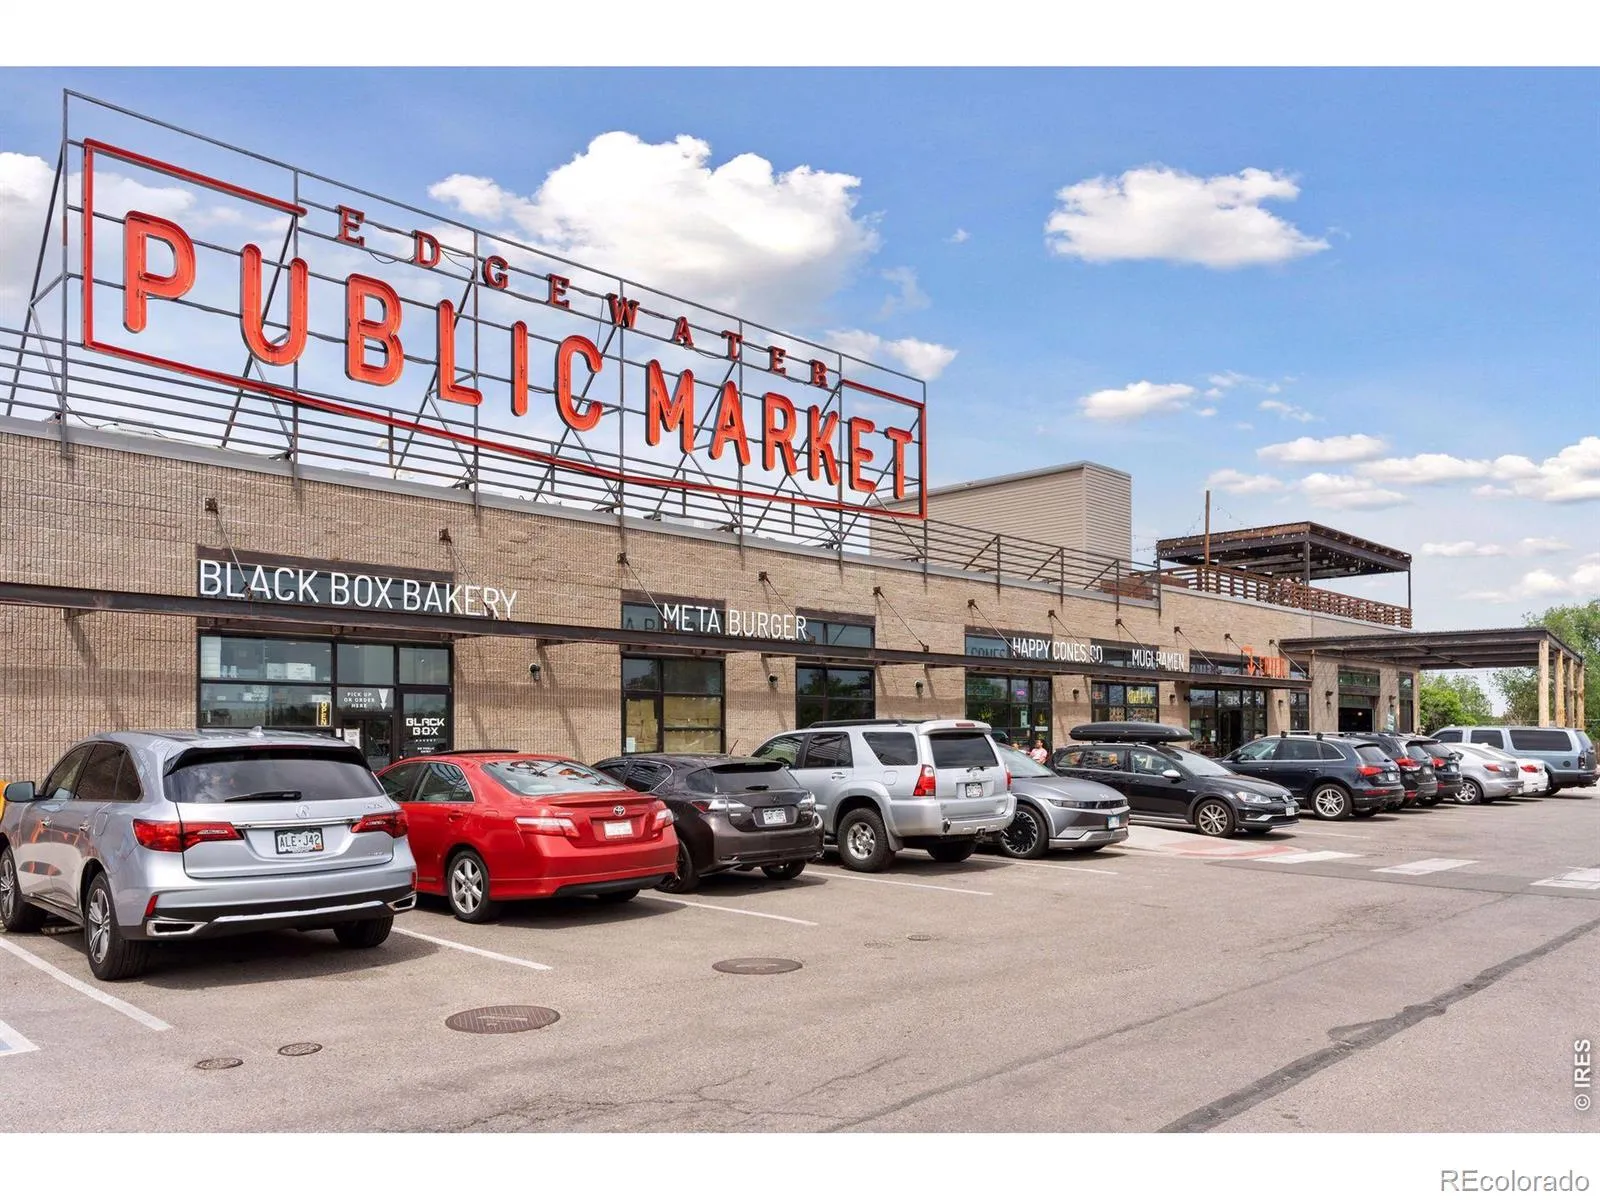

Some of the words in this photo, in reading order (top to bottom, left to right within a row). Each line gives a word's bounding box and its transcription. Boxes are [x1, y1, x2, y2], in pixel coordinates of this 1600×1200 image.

[336, 204, 829, 389] EDGEWATER
[123, 210, 603, 432] PUBLIC
[645, 359, 913, 500] MARKET
[199, 560, 320, 603] BLACK
[330, 572, 393, 609] BOX
[403, 579, 518, 620] BAKERY
[663, 602, 722, 634] META
[729, 609, 807, 640] BURGER
[1012, 636, 1051, 659] HAPPY
[1053, 641, 1087, 663] CONES
[1132, 648, 1155, 668] MUGI
[1156, 650, 1185, 672] RAMEN
[405, 717, 445, 727] BLACK
[412, 726, 439, 736] BOX
